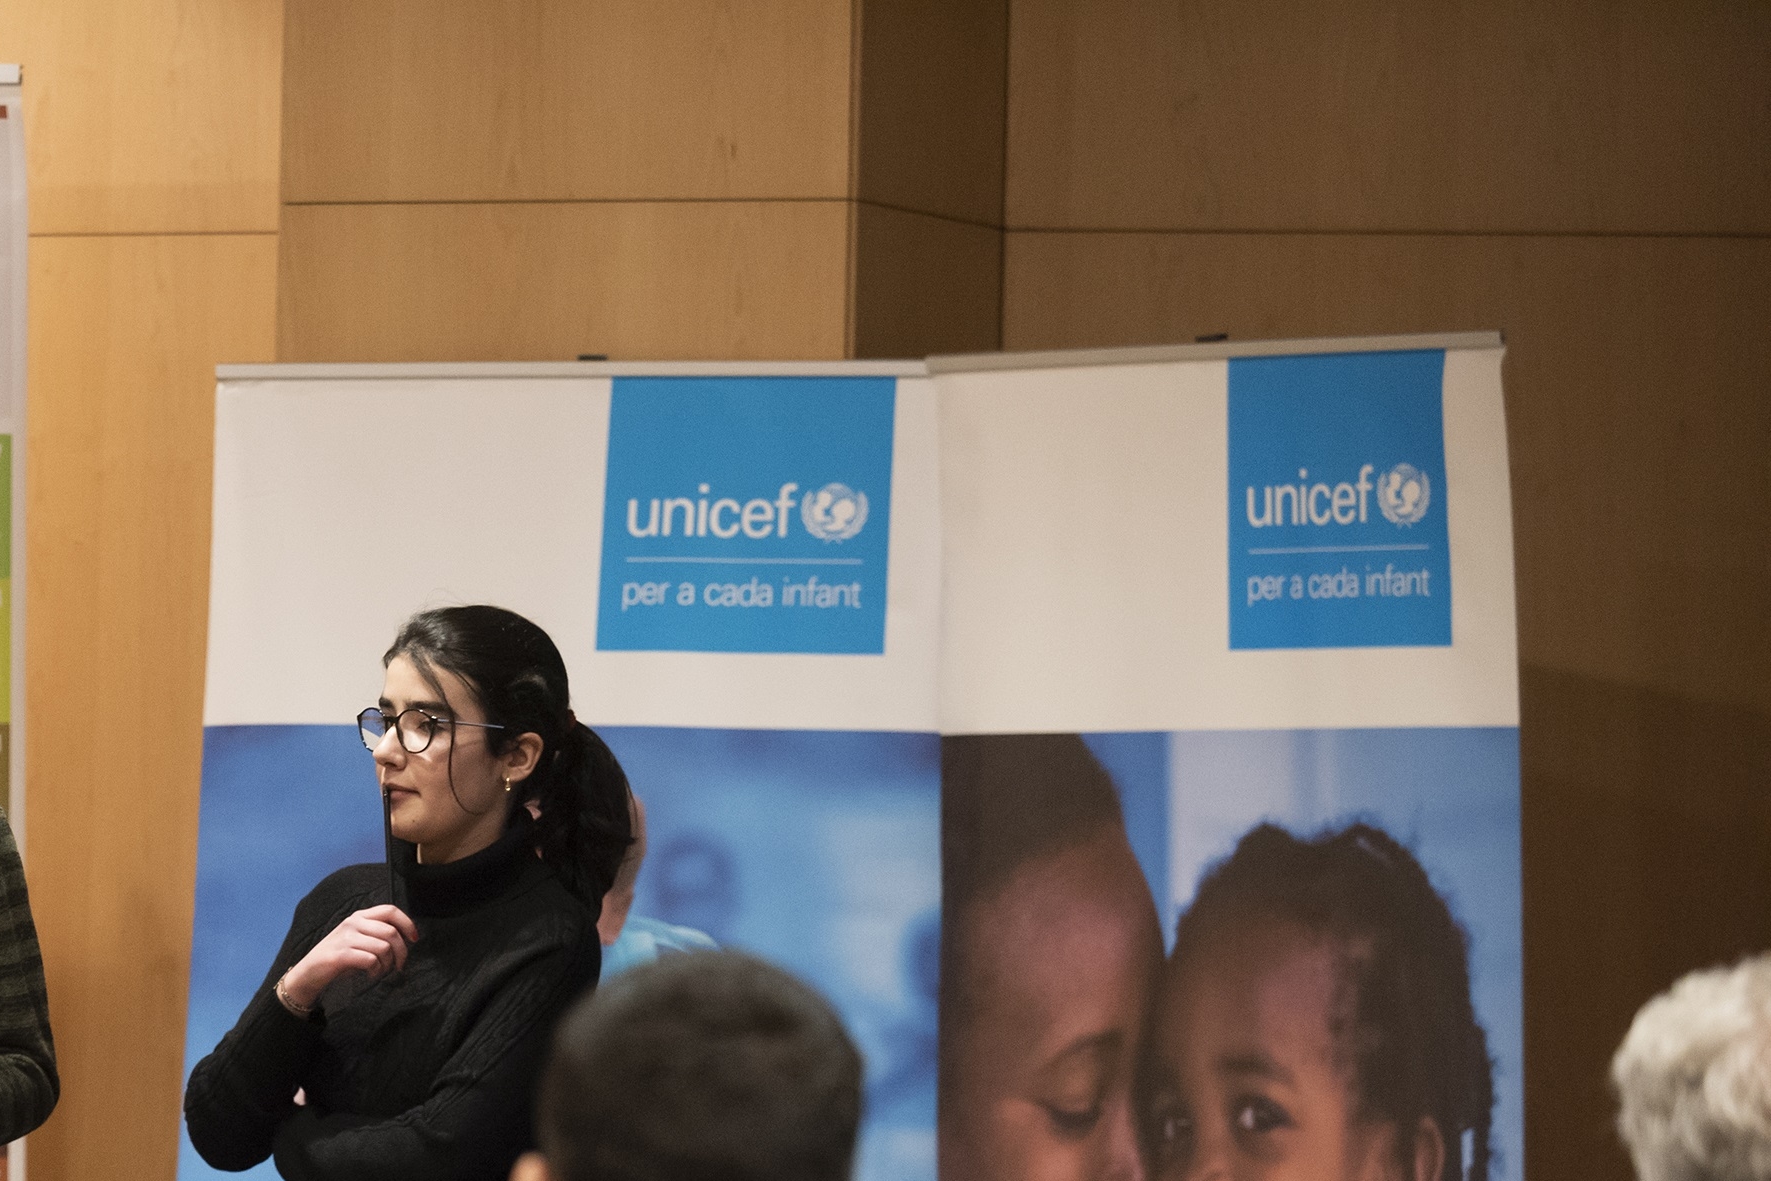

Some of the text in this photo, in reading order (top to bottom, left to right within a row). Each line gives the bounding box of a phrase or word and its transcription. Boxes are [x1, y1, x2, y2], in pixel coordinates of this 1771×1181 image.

[628, 483, 797, 538] unicef
[1247, 465, 1373, 527] unicef
[621, 576, 862, 612] per a cada infant
[1247, 564, 1430, 607] per a cada infant
